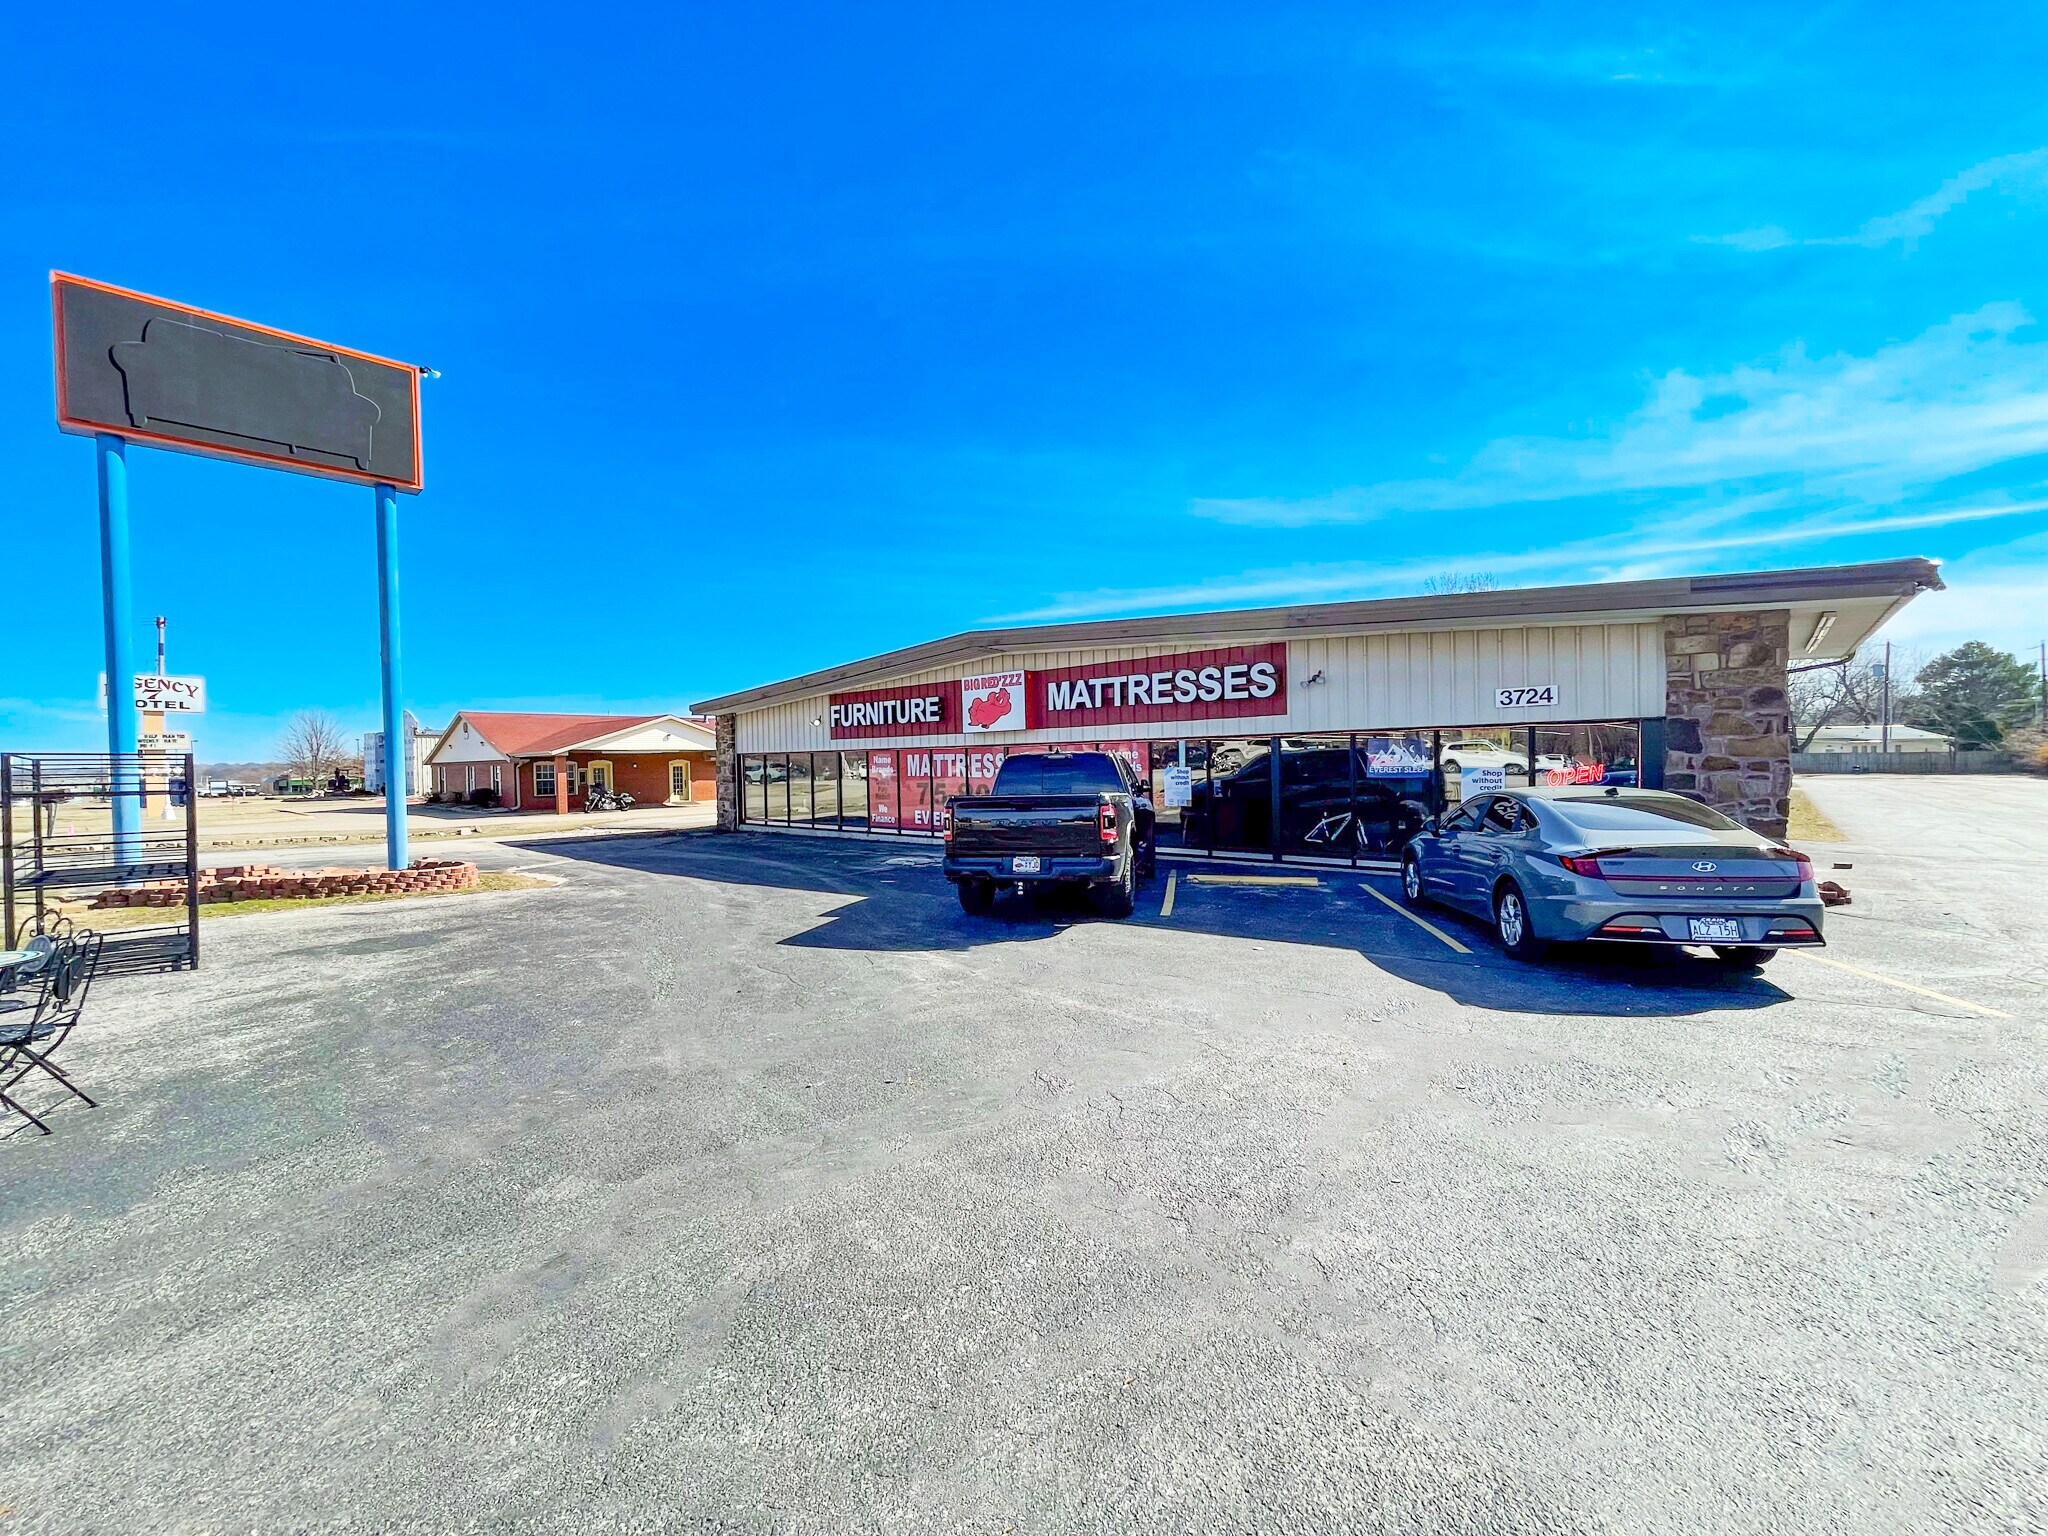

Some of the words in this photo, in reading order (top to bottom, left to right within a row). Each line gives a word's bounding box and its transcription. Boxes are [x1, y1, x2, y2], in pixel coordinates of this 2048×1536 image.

[104, 677, 199, 699] GENCY
[1047, 661, 1277, 712] MATTRESSES
[1500, 687, 1553, 705] 3724
[135, 700, 190, 709] OTEL
[830, 696, 940, 727] FURNITURE
[873, 755, 891, 764] Name
[1482, 769, 1502, 778] Shop
[1547, 764, 1604, 787] OPEN
[878, 804, 888, 813] We
[871, 814, 895, 824] Finance
